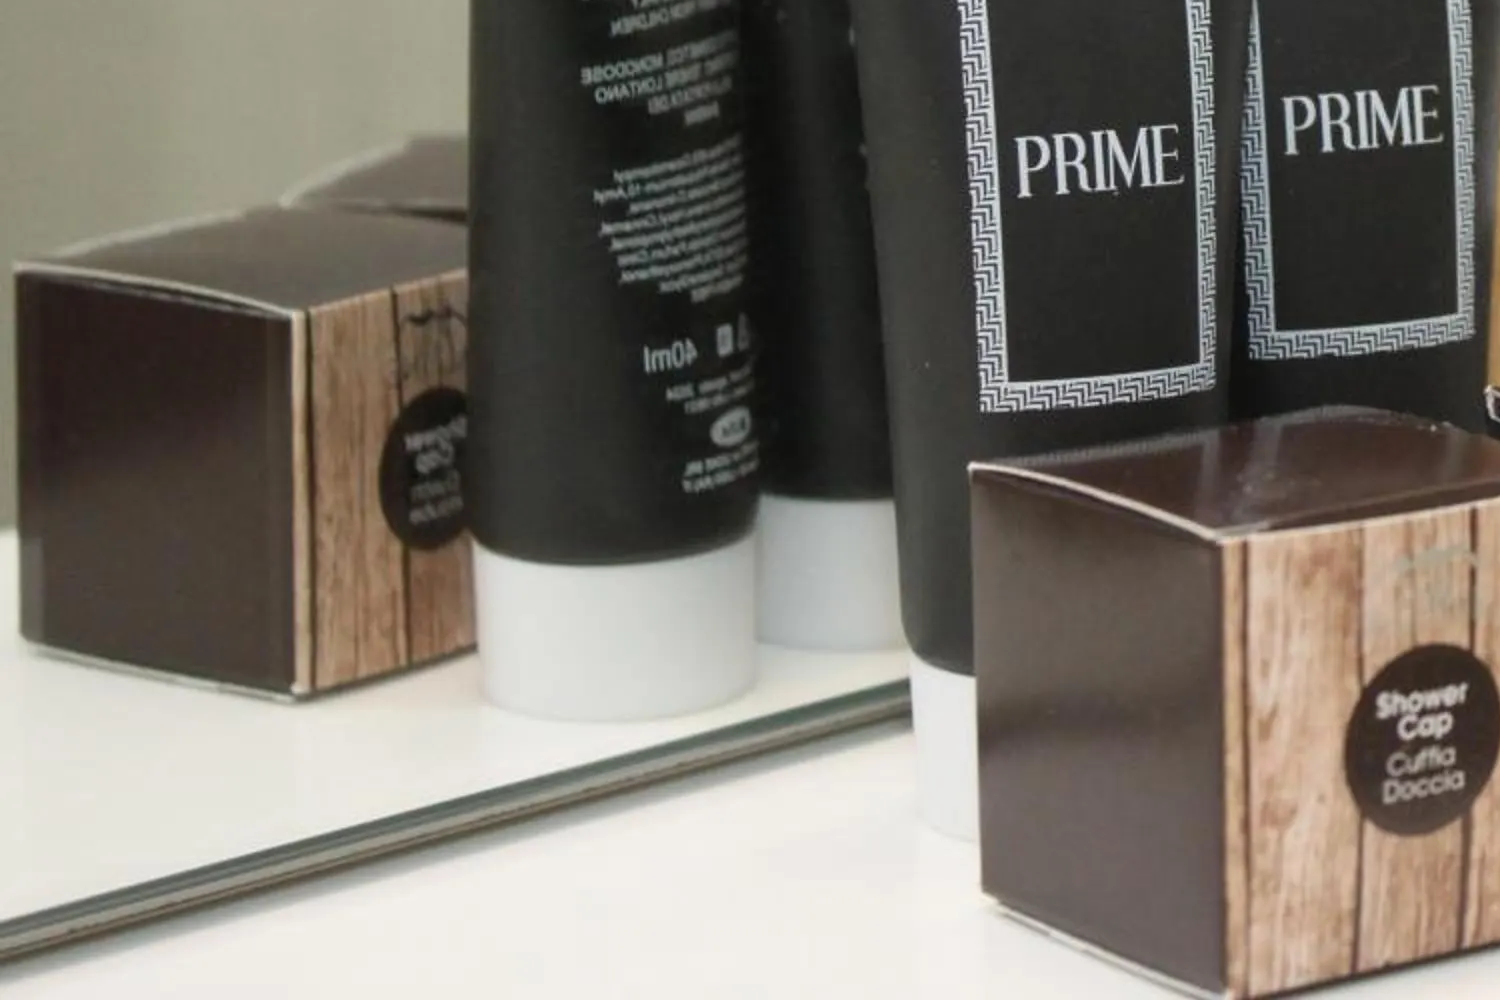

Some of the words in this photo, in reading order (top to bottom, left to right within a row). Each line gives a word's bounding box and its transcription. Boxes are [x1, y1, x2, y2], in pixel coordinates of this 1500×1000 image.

[1283, 84, 1444, 156] PRIME
[1013, 123, 1186, 199] PRIME
[1375, 681, 1469, 721] Shower
[1396, 711, 1454, 741] Cap
[1381, 769, 1466, 805] Doccia
